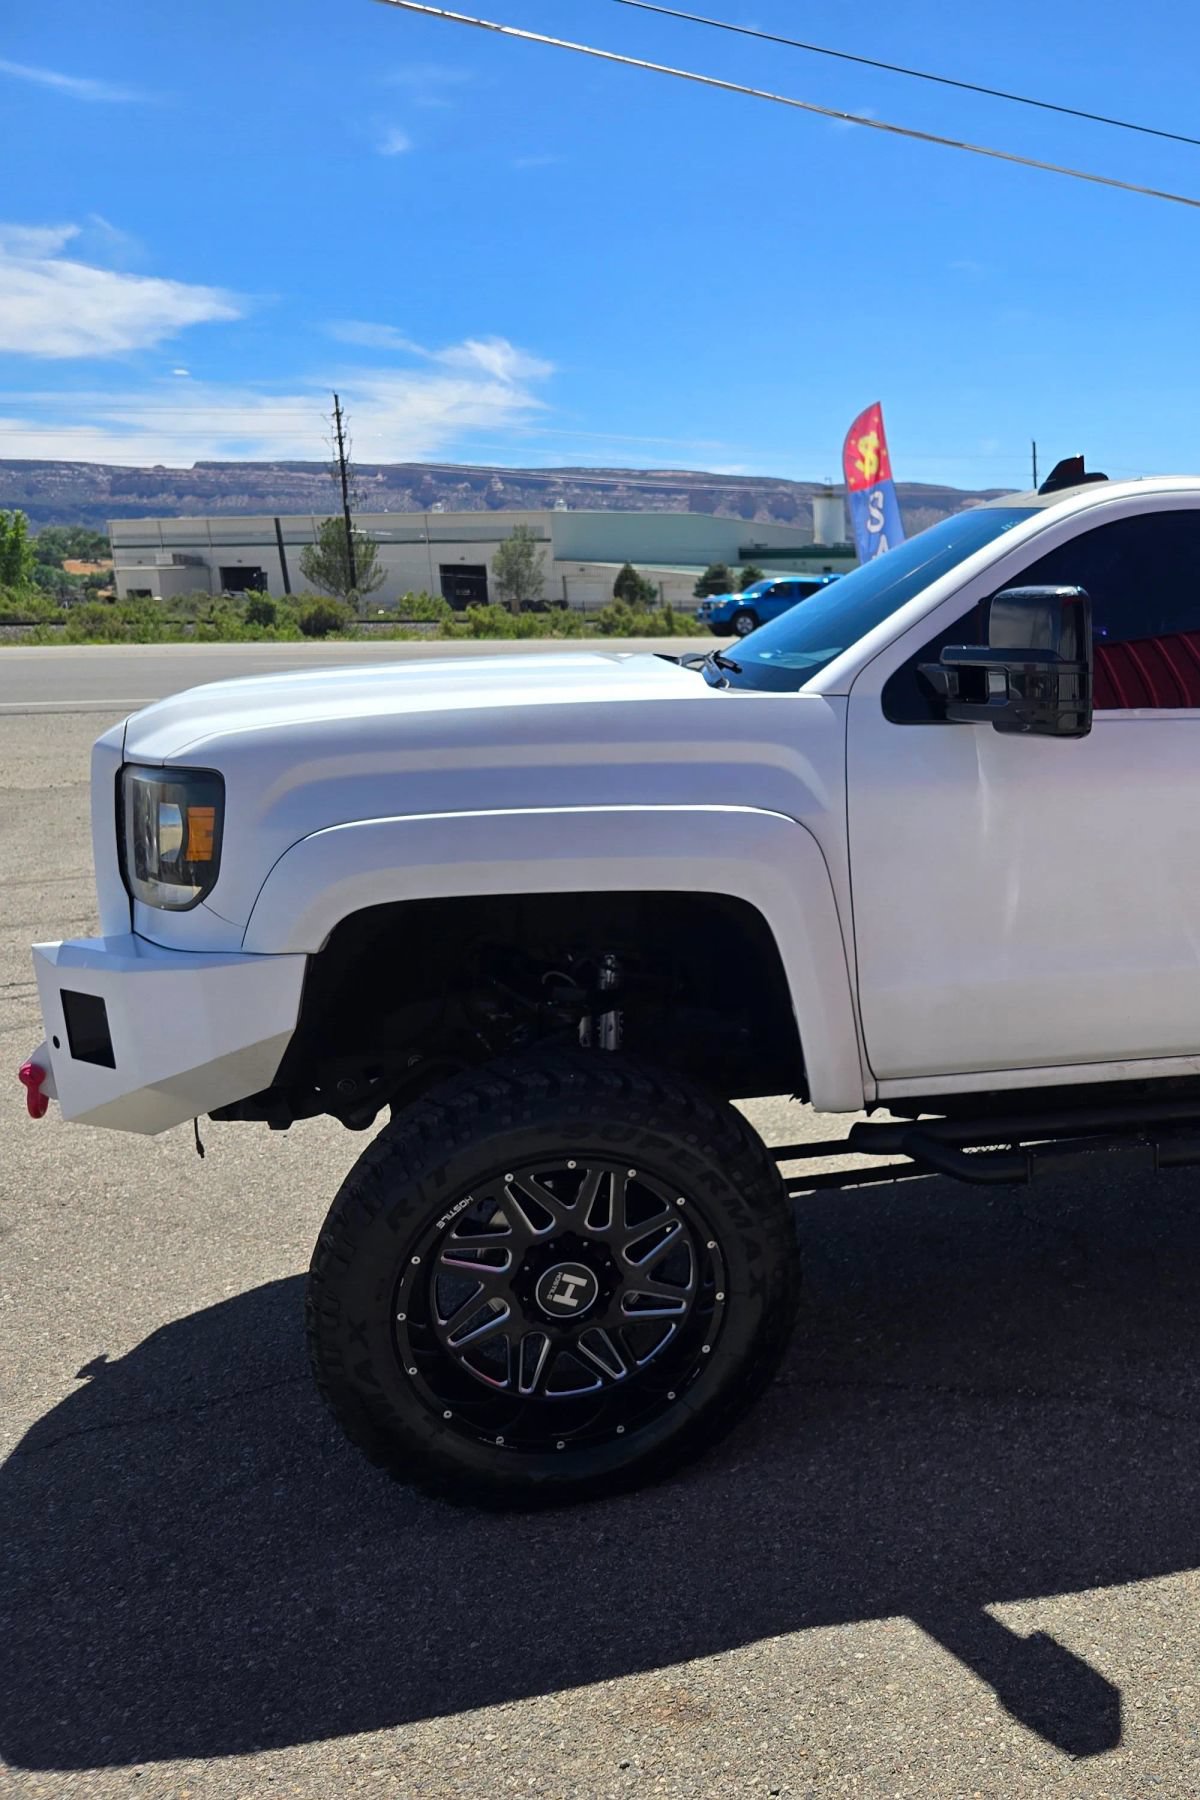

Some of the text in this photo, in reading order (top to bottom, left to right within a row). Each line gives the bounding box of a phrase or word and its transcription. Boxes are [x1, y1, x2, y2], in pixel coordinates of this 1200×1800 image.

[386, 1160, 451, 1235] R/T
[436, 1195, 474, 1229] HOSTILE
[562, 1120, 769, 1298] SUPERMAX
[552, 1273, 588, 1307] H
